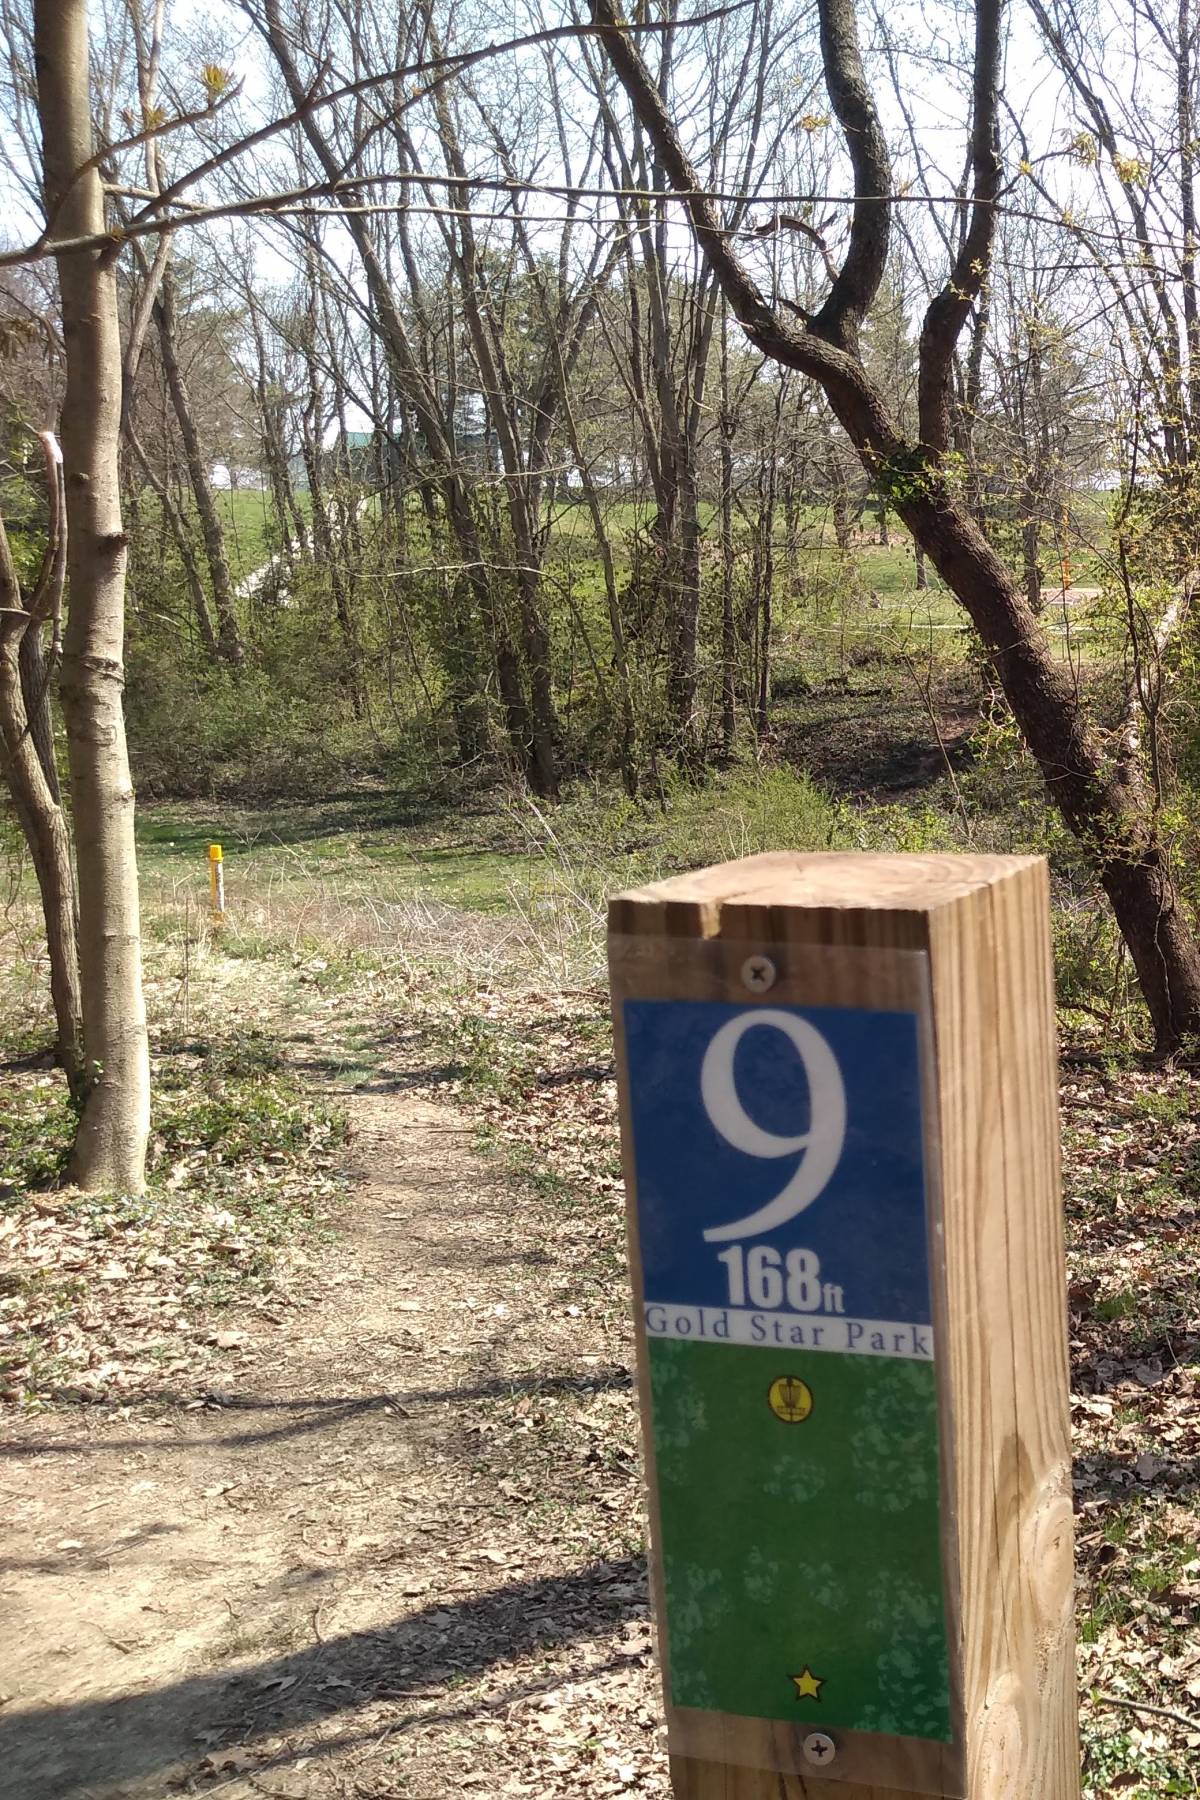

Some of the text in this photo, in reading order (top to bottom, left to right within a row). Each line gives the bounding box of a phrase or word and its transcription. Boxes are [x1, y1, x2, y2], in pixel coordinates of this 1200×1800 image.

[701, 1009, 847, 1242] 9
[645, 1306, 930, 1356] Gold Star Park
